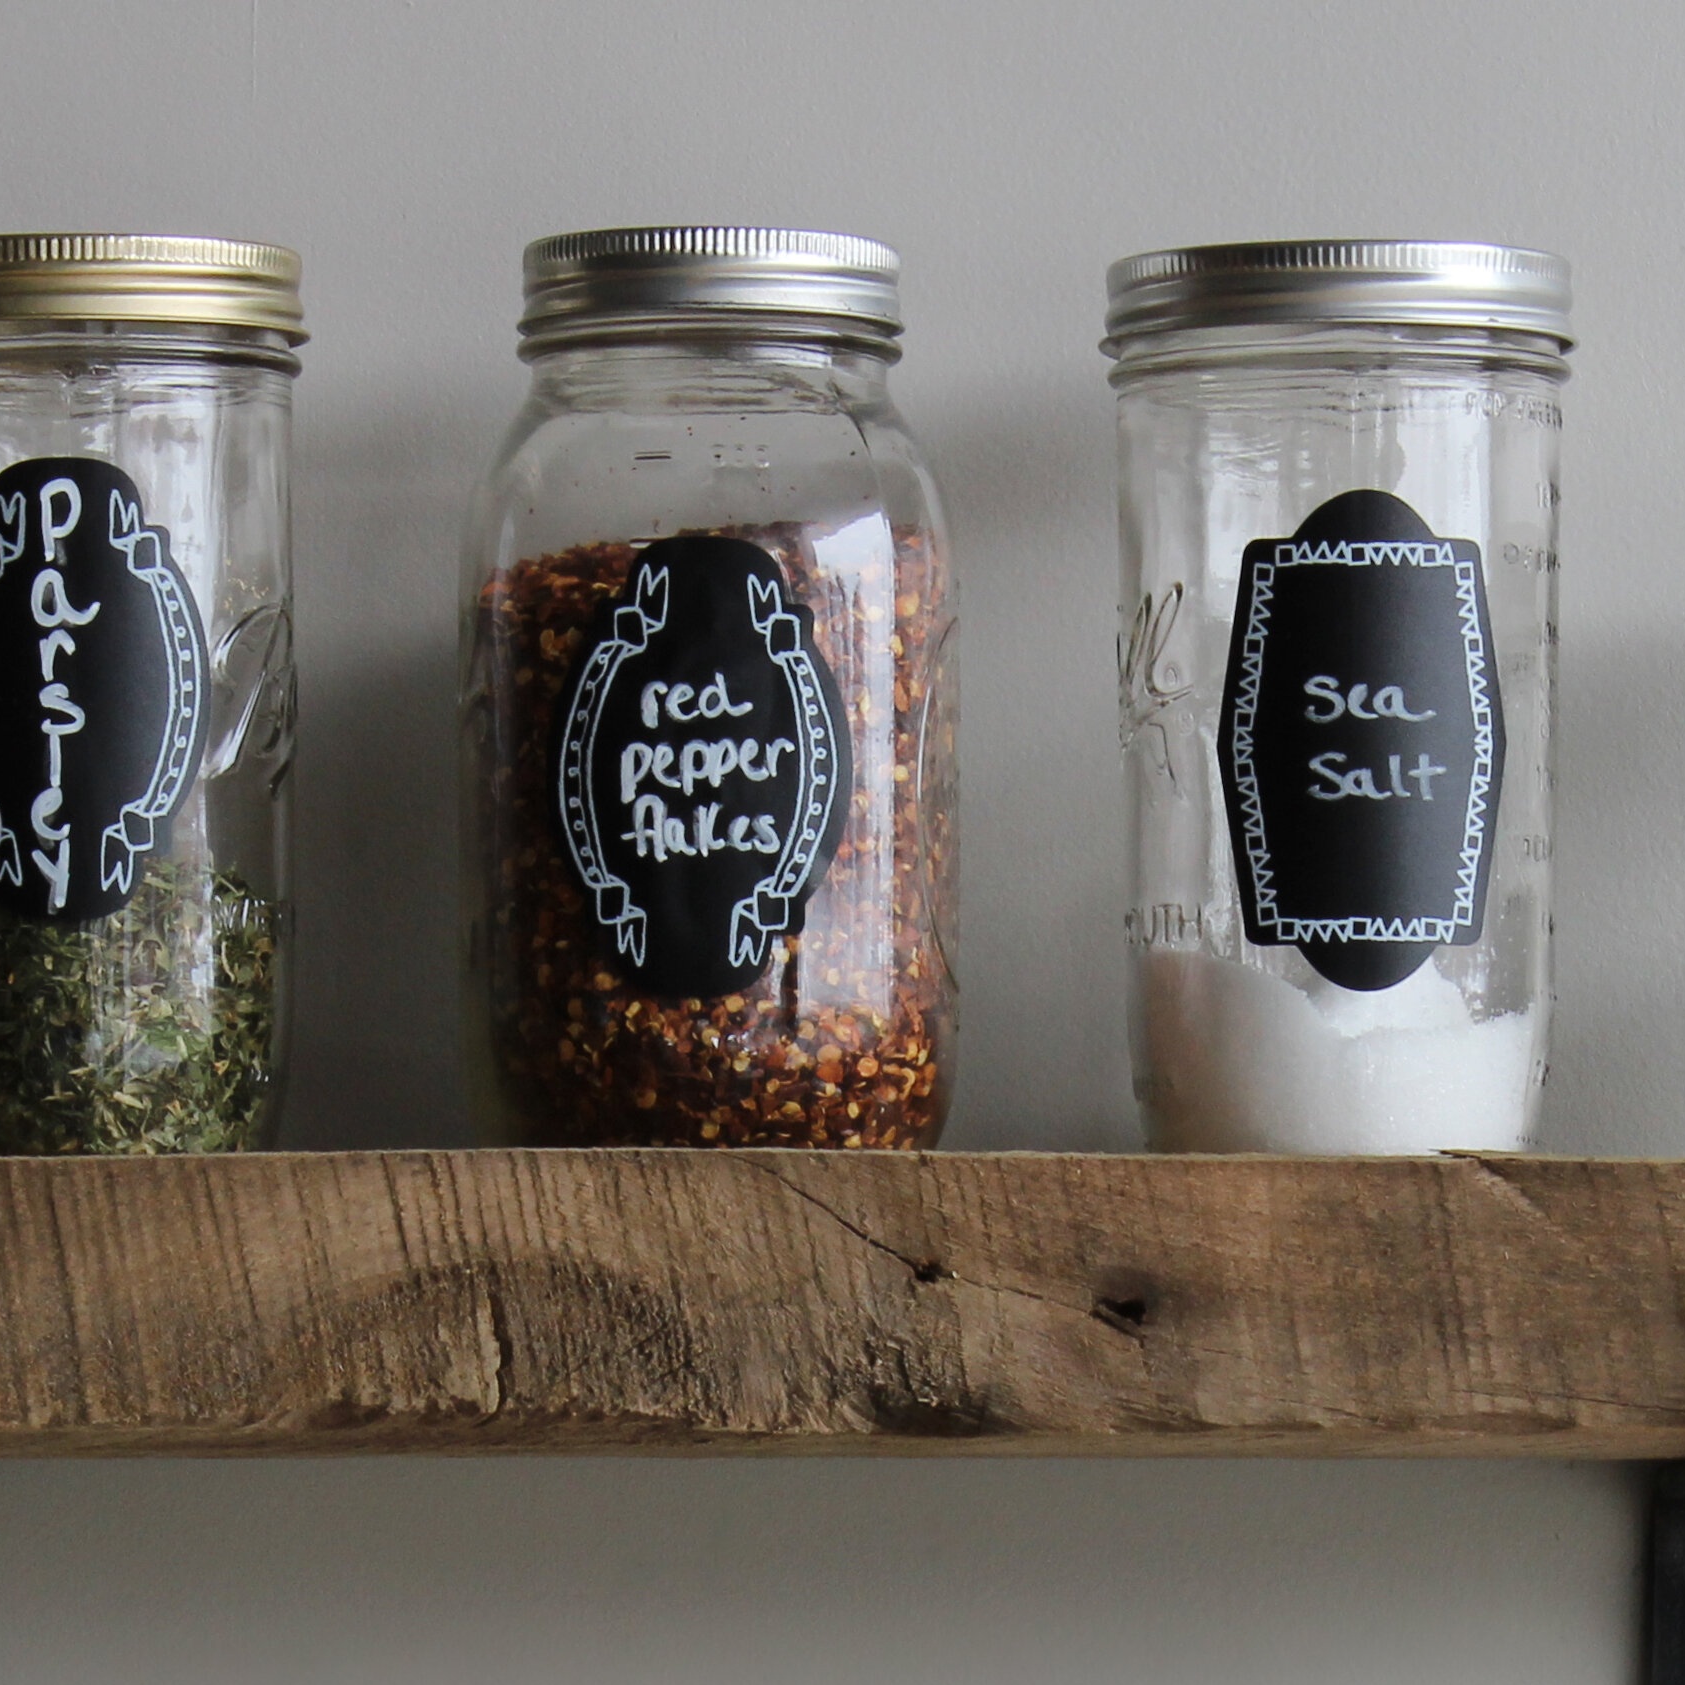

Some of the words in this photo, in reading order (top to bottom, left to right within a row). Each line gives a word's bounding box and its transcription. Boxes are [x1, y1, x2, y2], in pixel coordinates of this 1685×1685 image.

[640, 671, 755, 728] red
[1302, 675, 1437, 725] Sea
[620, 736, 796, 804] pepper
[1306, 752, 1447, 802] Salt
